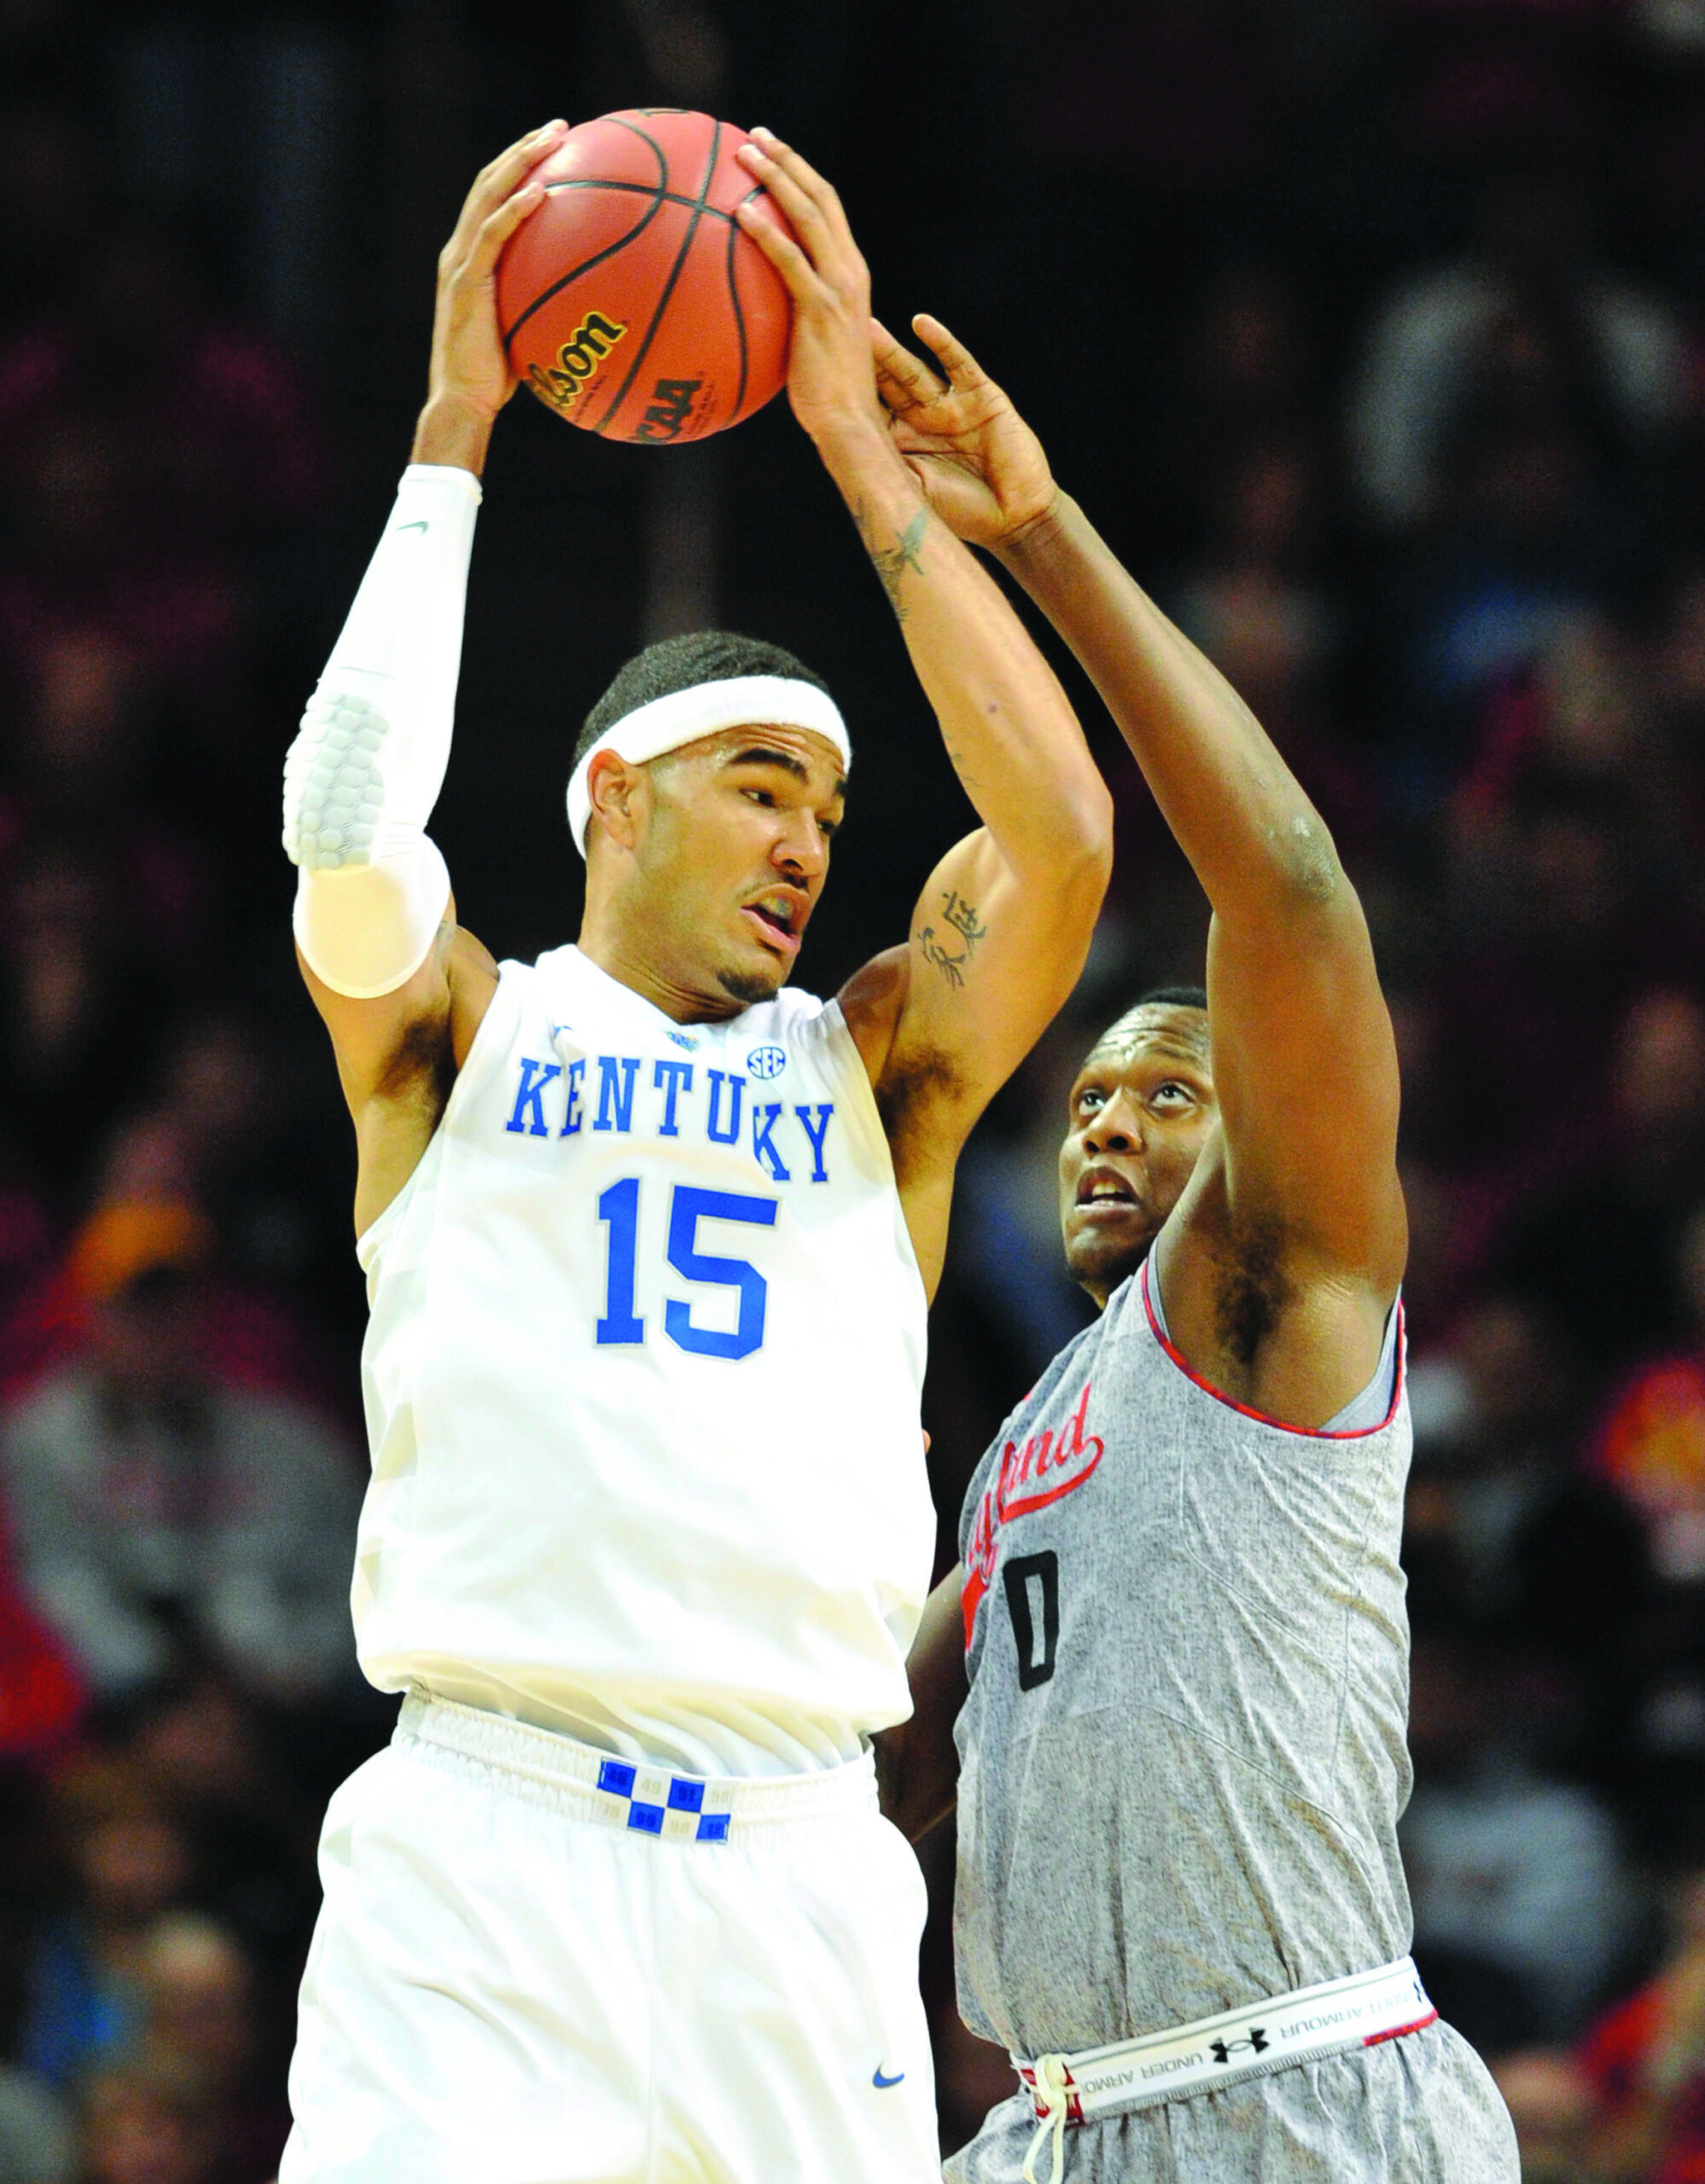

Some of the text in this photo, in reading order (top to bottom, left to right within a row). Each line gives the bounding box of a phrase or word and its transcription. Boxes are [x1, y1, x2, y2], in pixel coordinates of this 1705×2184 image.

[630, 378, 703, 444] CAA
[747, 1046, 786, 1080] SEC
[503, 1054, 835, 1183] KENTUKY
[593, 1175, 780, 1364] 15
[1002, 1549, 1059, 1692] 0
[1081, 2052, 1204, 2094] UNDER ARMO
